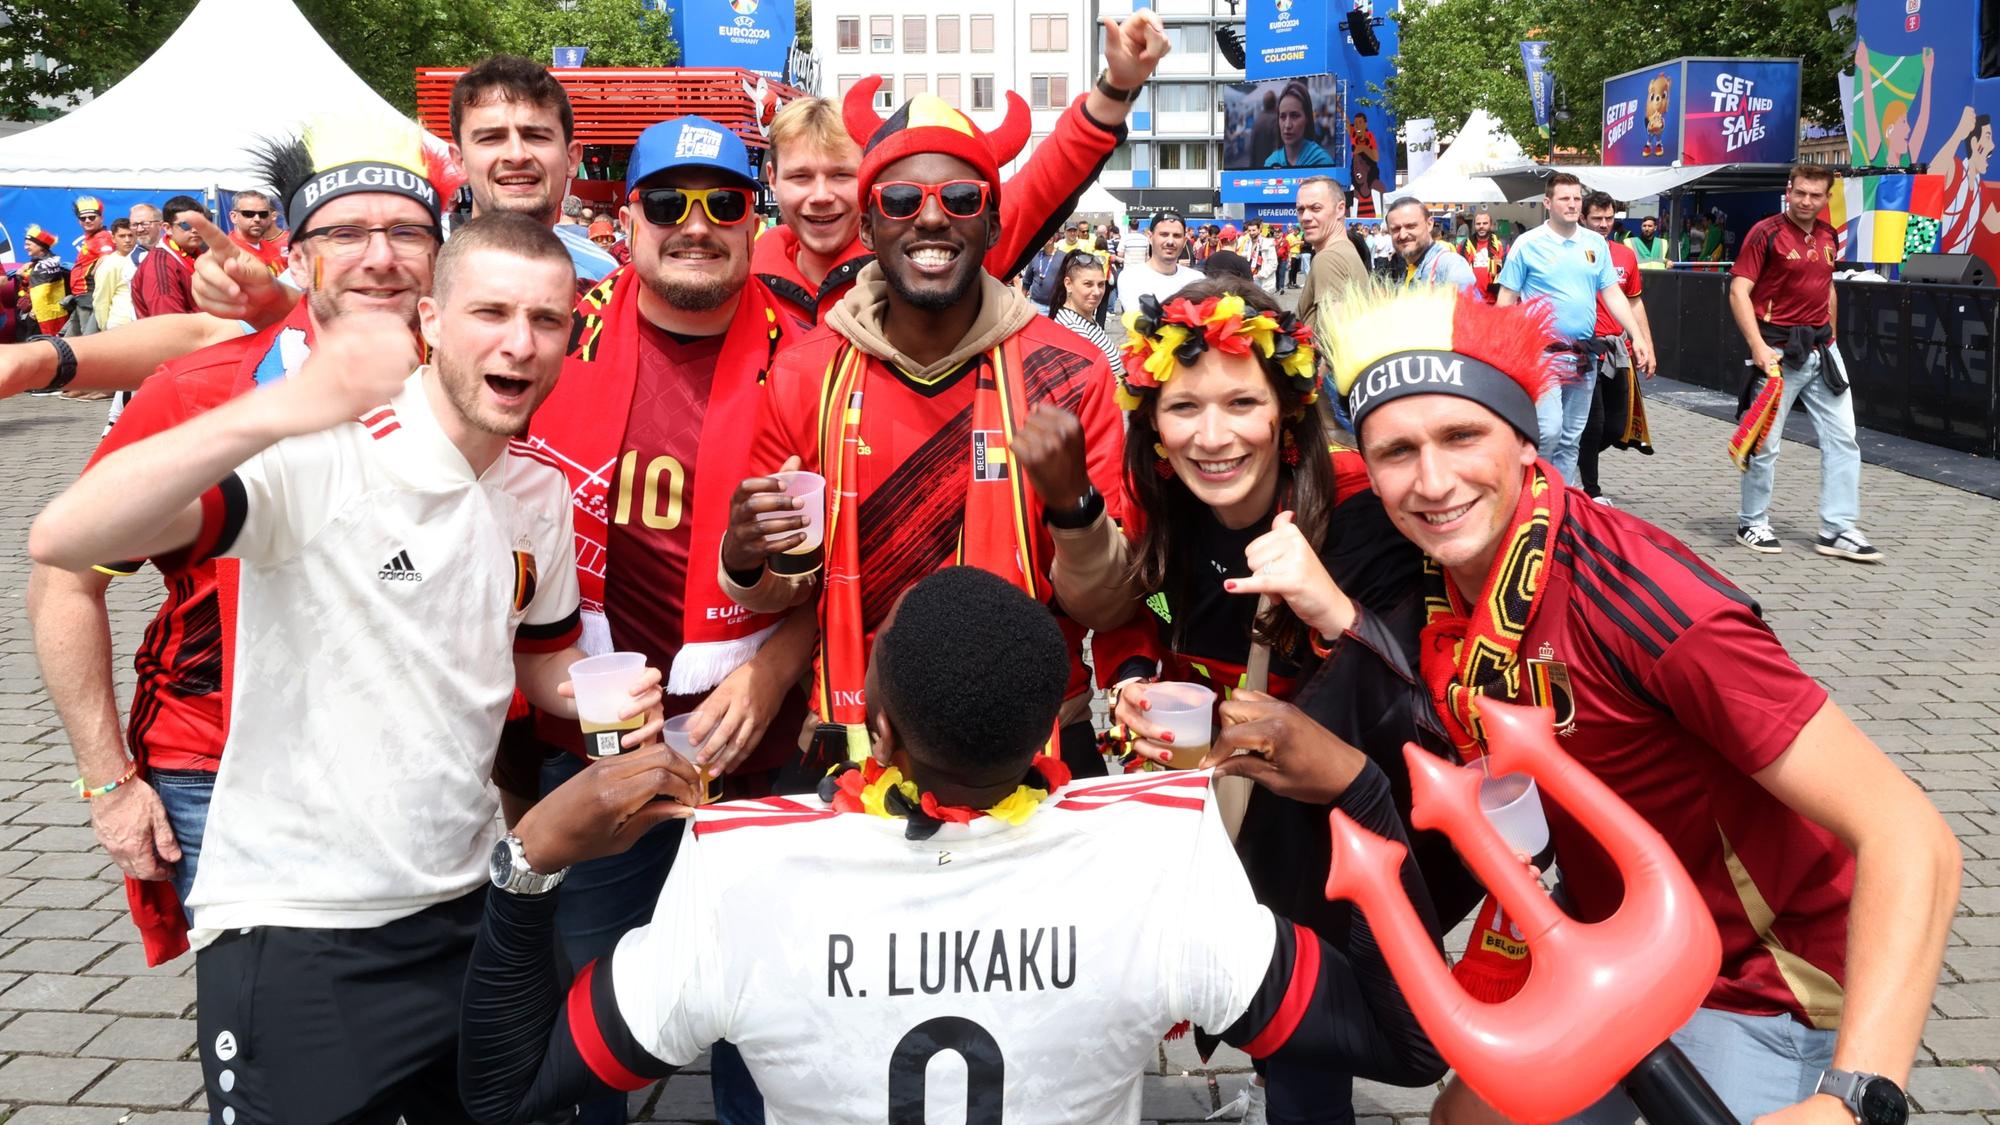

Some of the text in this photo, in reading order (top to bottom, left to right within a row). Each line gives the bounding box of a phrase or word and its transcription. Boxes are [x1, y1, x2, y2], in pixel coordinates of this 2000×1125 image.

[719, 26, 770, 39] EURO2024
[1264, 51, 1305, 63] COLOGNE
[1716, 73, 1754, 94] GET
[1727, 126, 1765, 152] LIVES
[304, 167, 434, 208] BELGIUM
[1349, 355, 1465, 421] ELGIUM
[614, 449, 685, 531] 10
[378, 569, 423, 582] adidas
[1486, 934, 1528, 955] BELGIU
[827, 925, 1076, 998] R. LUKAKU
